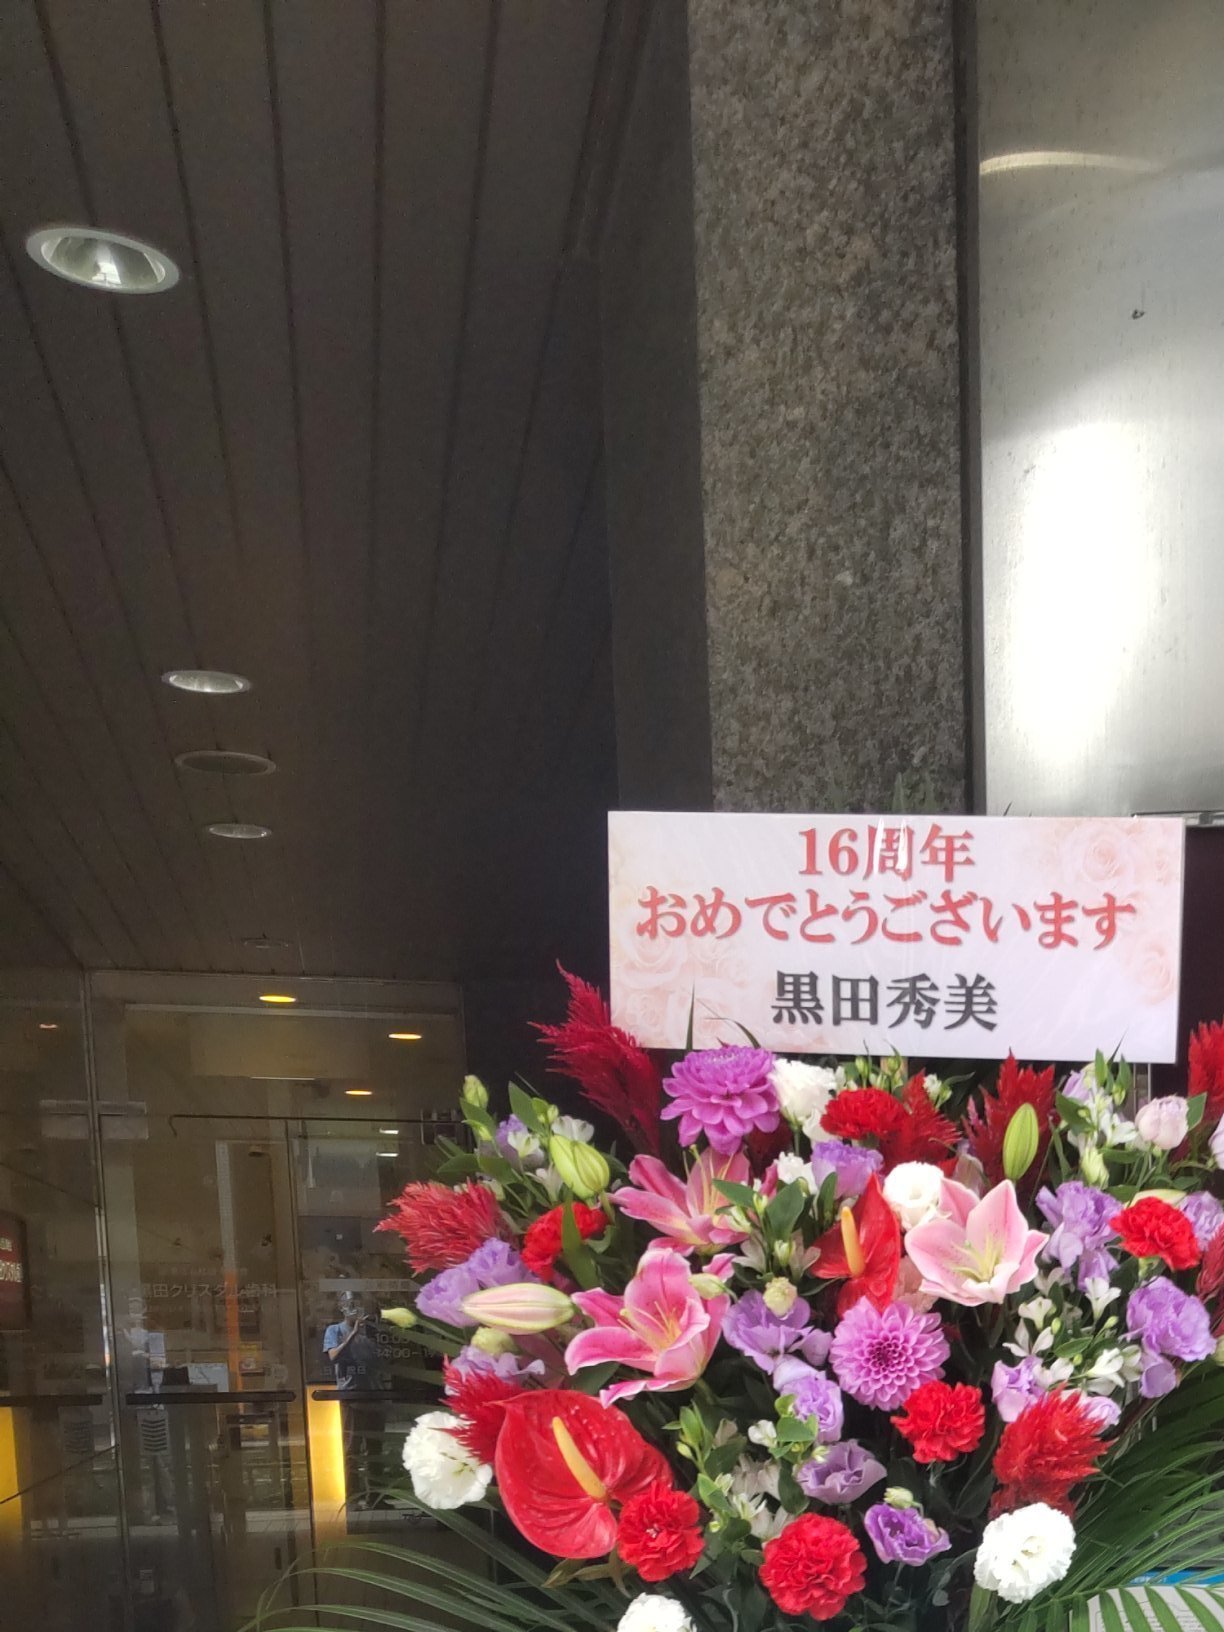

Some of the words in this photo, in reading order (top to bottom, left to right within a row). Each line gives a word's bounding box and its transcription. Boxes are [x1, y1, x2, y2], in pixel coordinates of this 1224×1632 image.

[798, 822, 976, 883] 16周年
[635, 886, 1137, 951] おめでとうございます
[770, 970, 998, 1032] 黒田秀美
